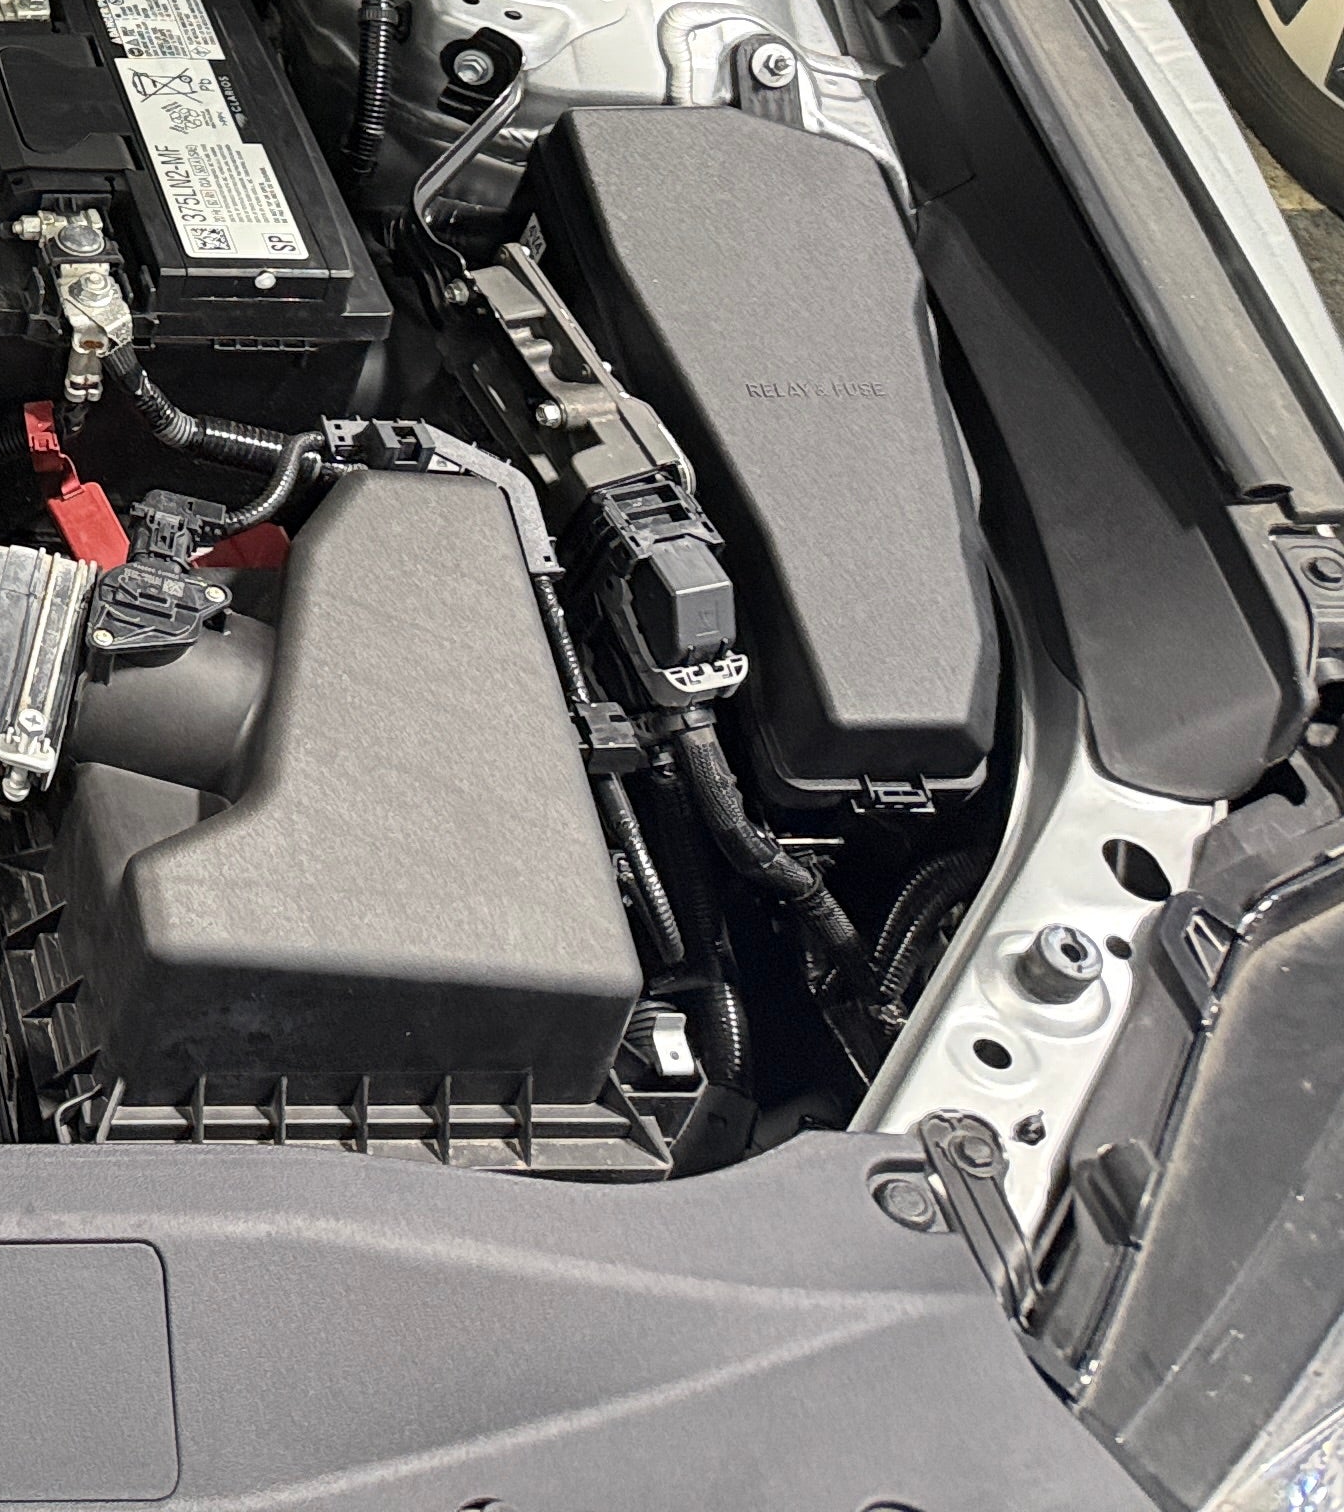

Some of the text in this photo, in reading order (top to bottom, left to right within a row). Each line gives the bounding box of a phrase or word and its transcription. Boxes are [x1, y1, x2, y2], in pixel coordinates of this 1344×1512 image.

[198, 78, 214, 93] Pb
[218, 76, 242, 113] CLARIOS
[155, 144, 207, 222] 375LN2-MF
[268, 236, 297, 252] SP
[745, 381, 810, 398] RELAY
[831, 379, 887, 397] FUSE
